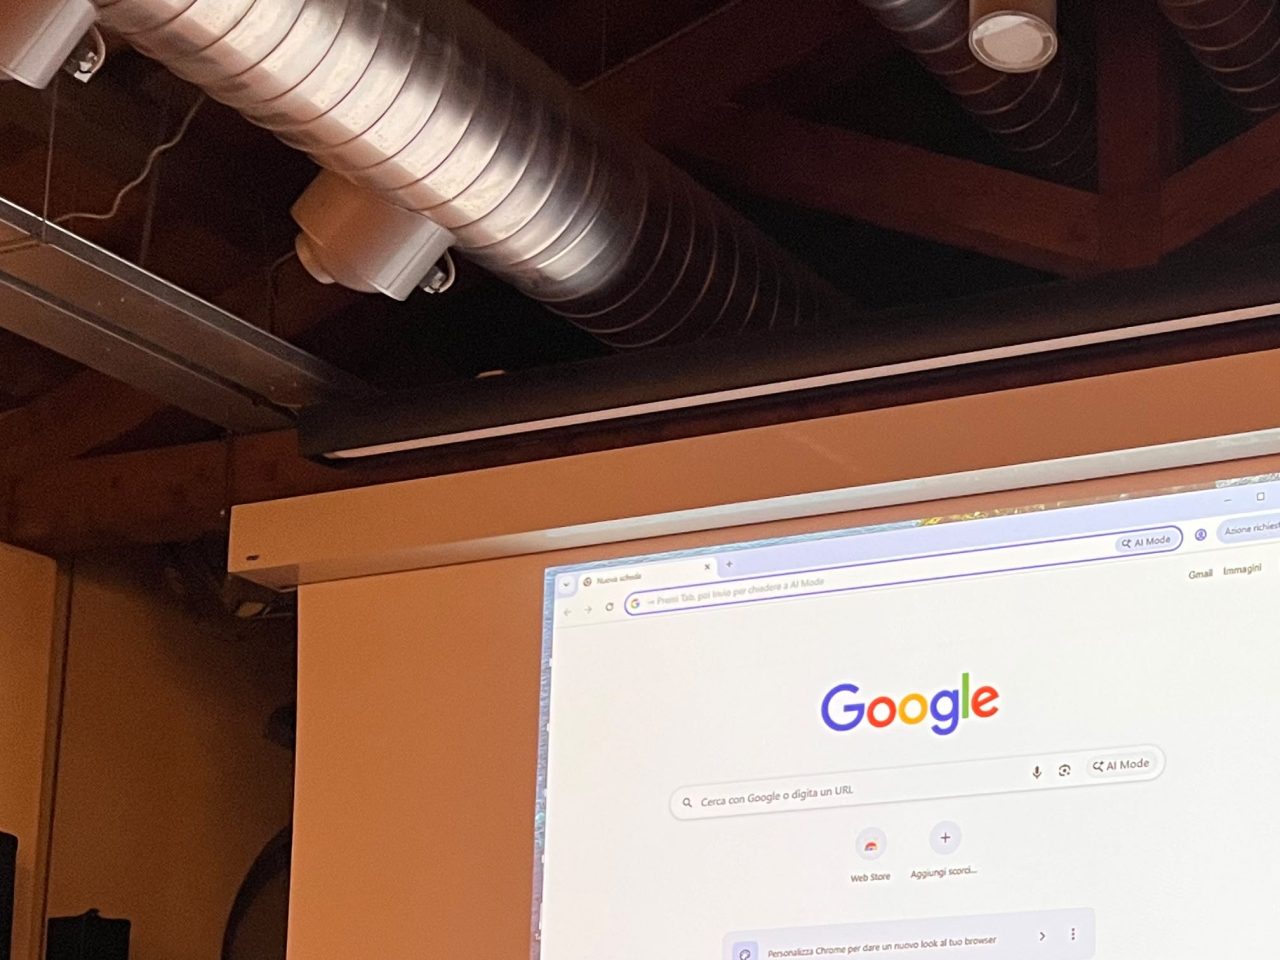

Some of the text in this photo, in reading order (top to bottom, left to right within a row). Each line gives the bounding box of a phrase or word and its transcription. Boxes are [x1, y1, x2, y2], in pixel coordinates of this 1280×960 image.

[1224, 526, 1252, 536] Azione
[1134, 535, 1171, 548] AI Mode
[1188, 562, 1262, 580] Gmail Immagini
[732, 587, 746, 598] per
[747, 582, 782, 594] chiedere
[800, 577, 825, 588] Mode
[820, 672, 1000, 736] Google
[1106, 757, 1150, 771] AI Mode
[700, 785, 854, 807] Cerca con Google o digita un URL
[850, 872, 891, 883] Web Store
[910, 867, 947, 881] Aggiungi
[768, 936, 997, 958] Personalizza Chrome per dare un nuovo look al tuo browser
